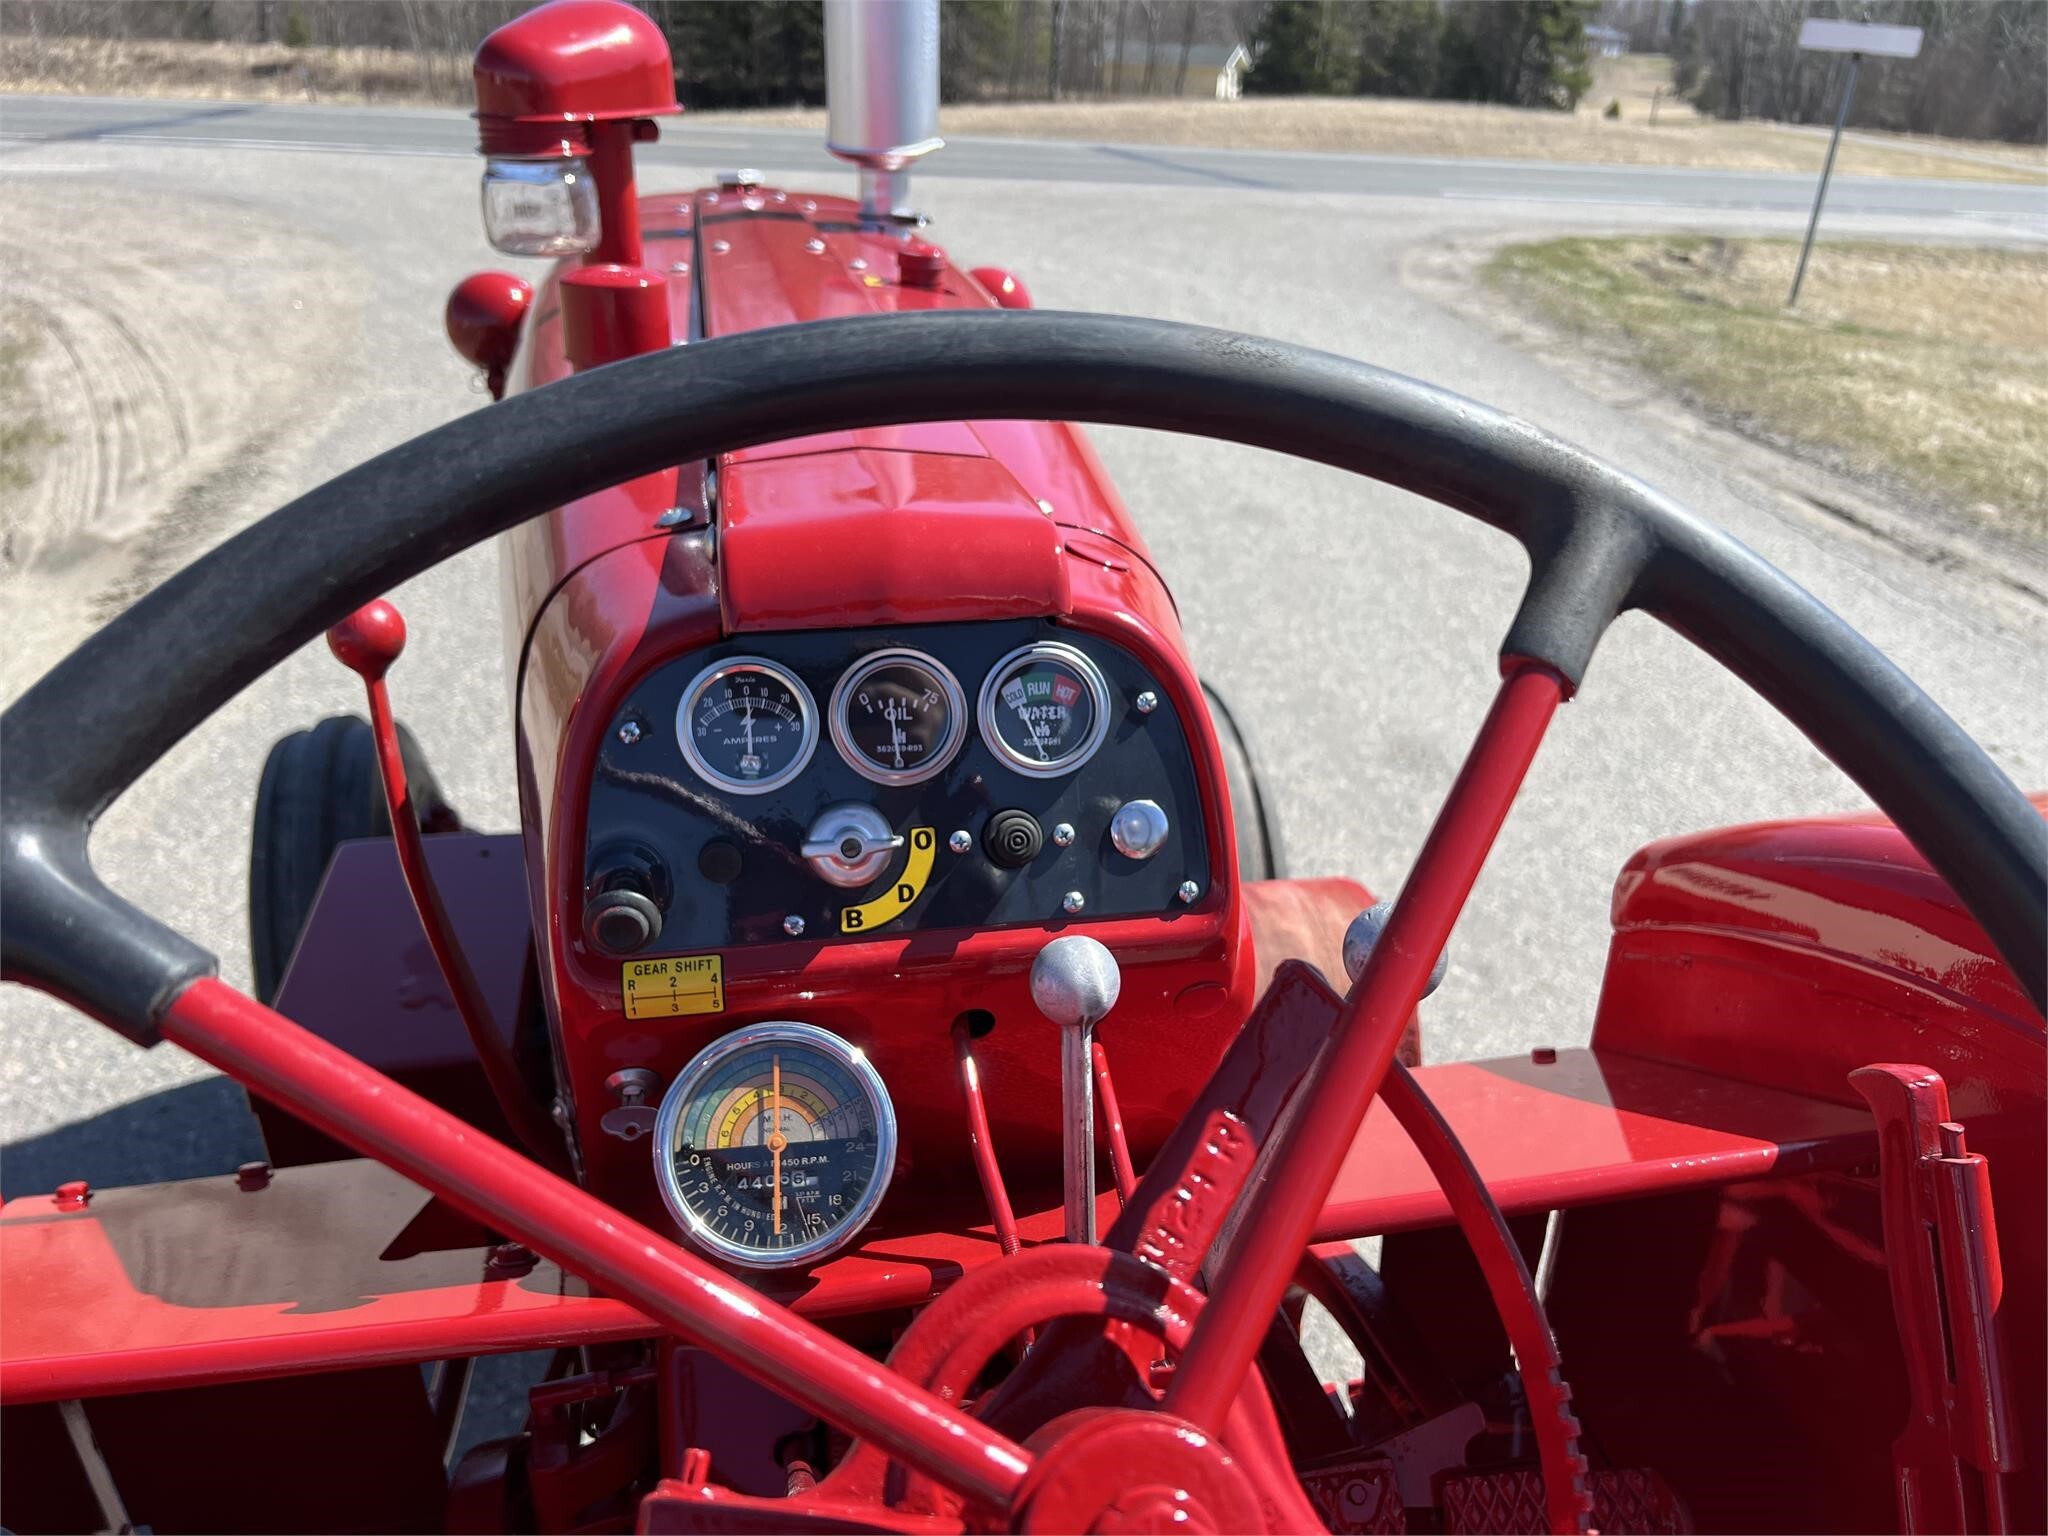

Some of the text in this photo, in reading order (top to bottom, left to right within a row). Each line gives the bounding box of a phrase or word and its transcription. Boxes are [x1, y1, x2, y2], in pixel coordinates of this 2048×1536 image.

[858, 688, 940, 705] 0 75
[1005, 681, 1077, 703] COLD RUN HOT
[696, 686, 801, 737] 30 20 10 0 10 20 30
[884, 707, 913, 721] OIL
[1017, 705, 1067, 720] WATER
[723, 735, 778, 745] AMPRES
[898, 884, 915, 902] D
[846, 909, 864, 928] B
[634, 958, 713, 976] GEAR SHIFT
[628, 973, 719, 990] R 2 4
[631, 999, 721, 1015] 1 3 5
[721, 1130, 730, 1138] 6
[732, 1106, 741, 1115] 5
[799, 1090, 808, 1099] 2
[846, 1142, 865, 1153] 24
[690, 1154, 700, 1166] 0
[727, 1161, 761, 1171] HOURS
[778, 1158, 800, 1167] 450
[801, 1155, 830, 1165] R.P.M.
[704, 1156, 718, 1184] ENGINE
[842, 1170, 857, 1182] 21
[698, 1182, 710, 1193] 3
[828, 1194, 842, 1206] 18
[717, 1205, 728, 1216] 6
[744, 1220, 754, 1231] 9
[806, 1213, 821, 1225] 15
